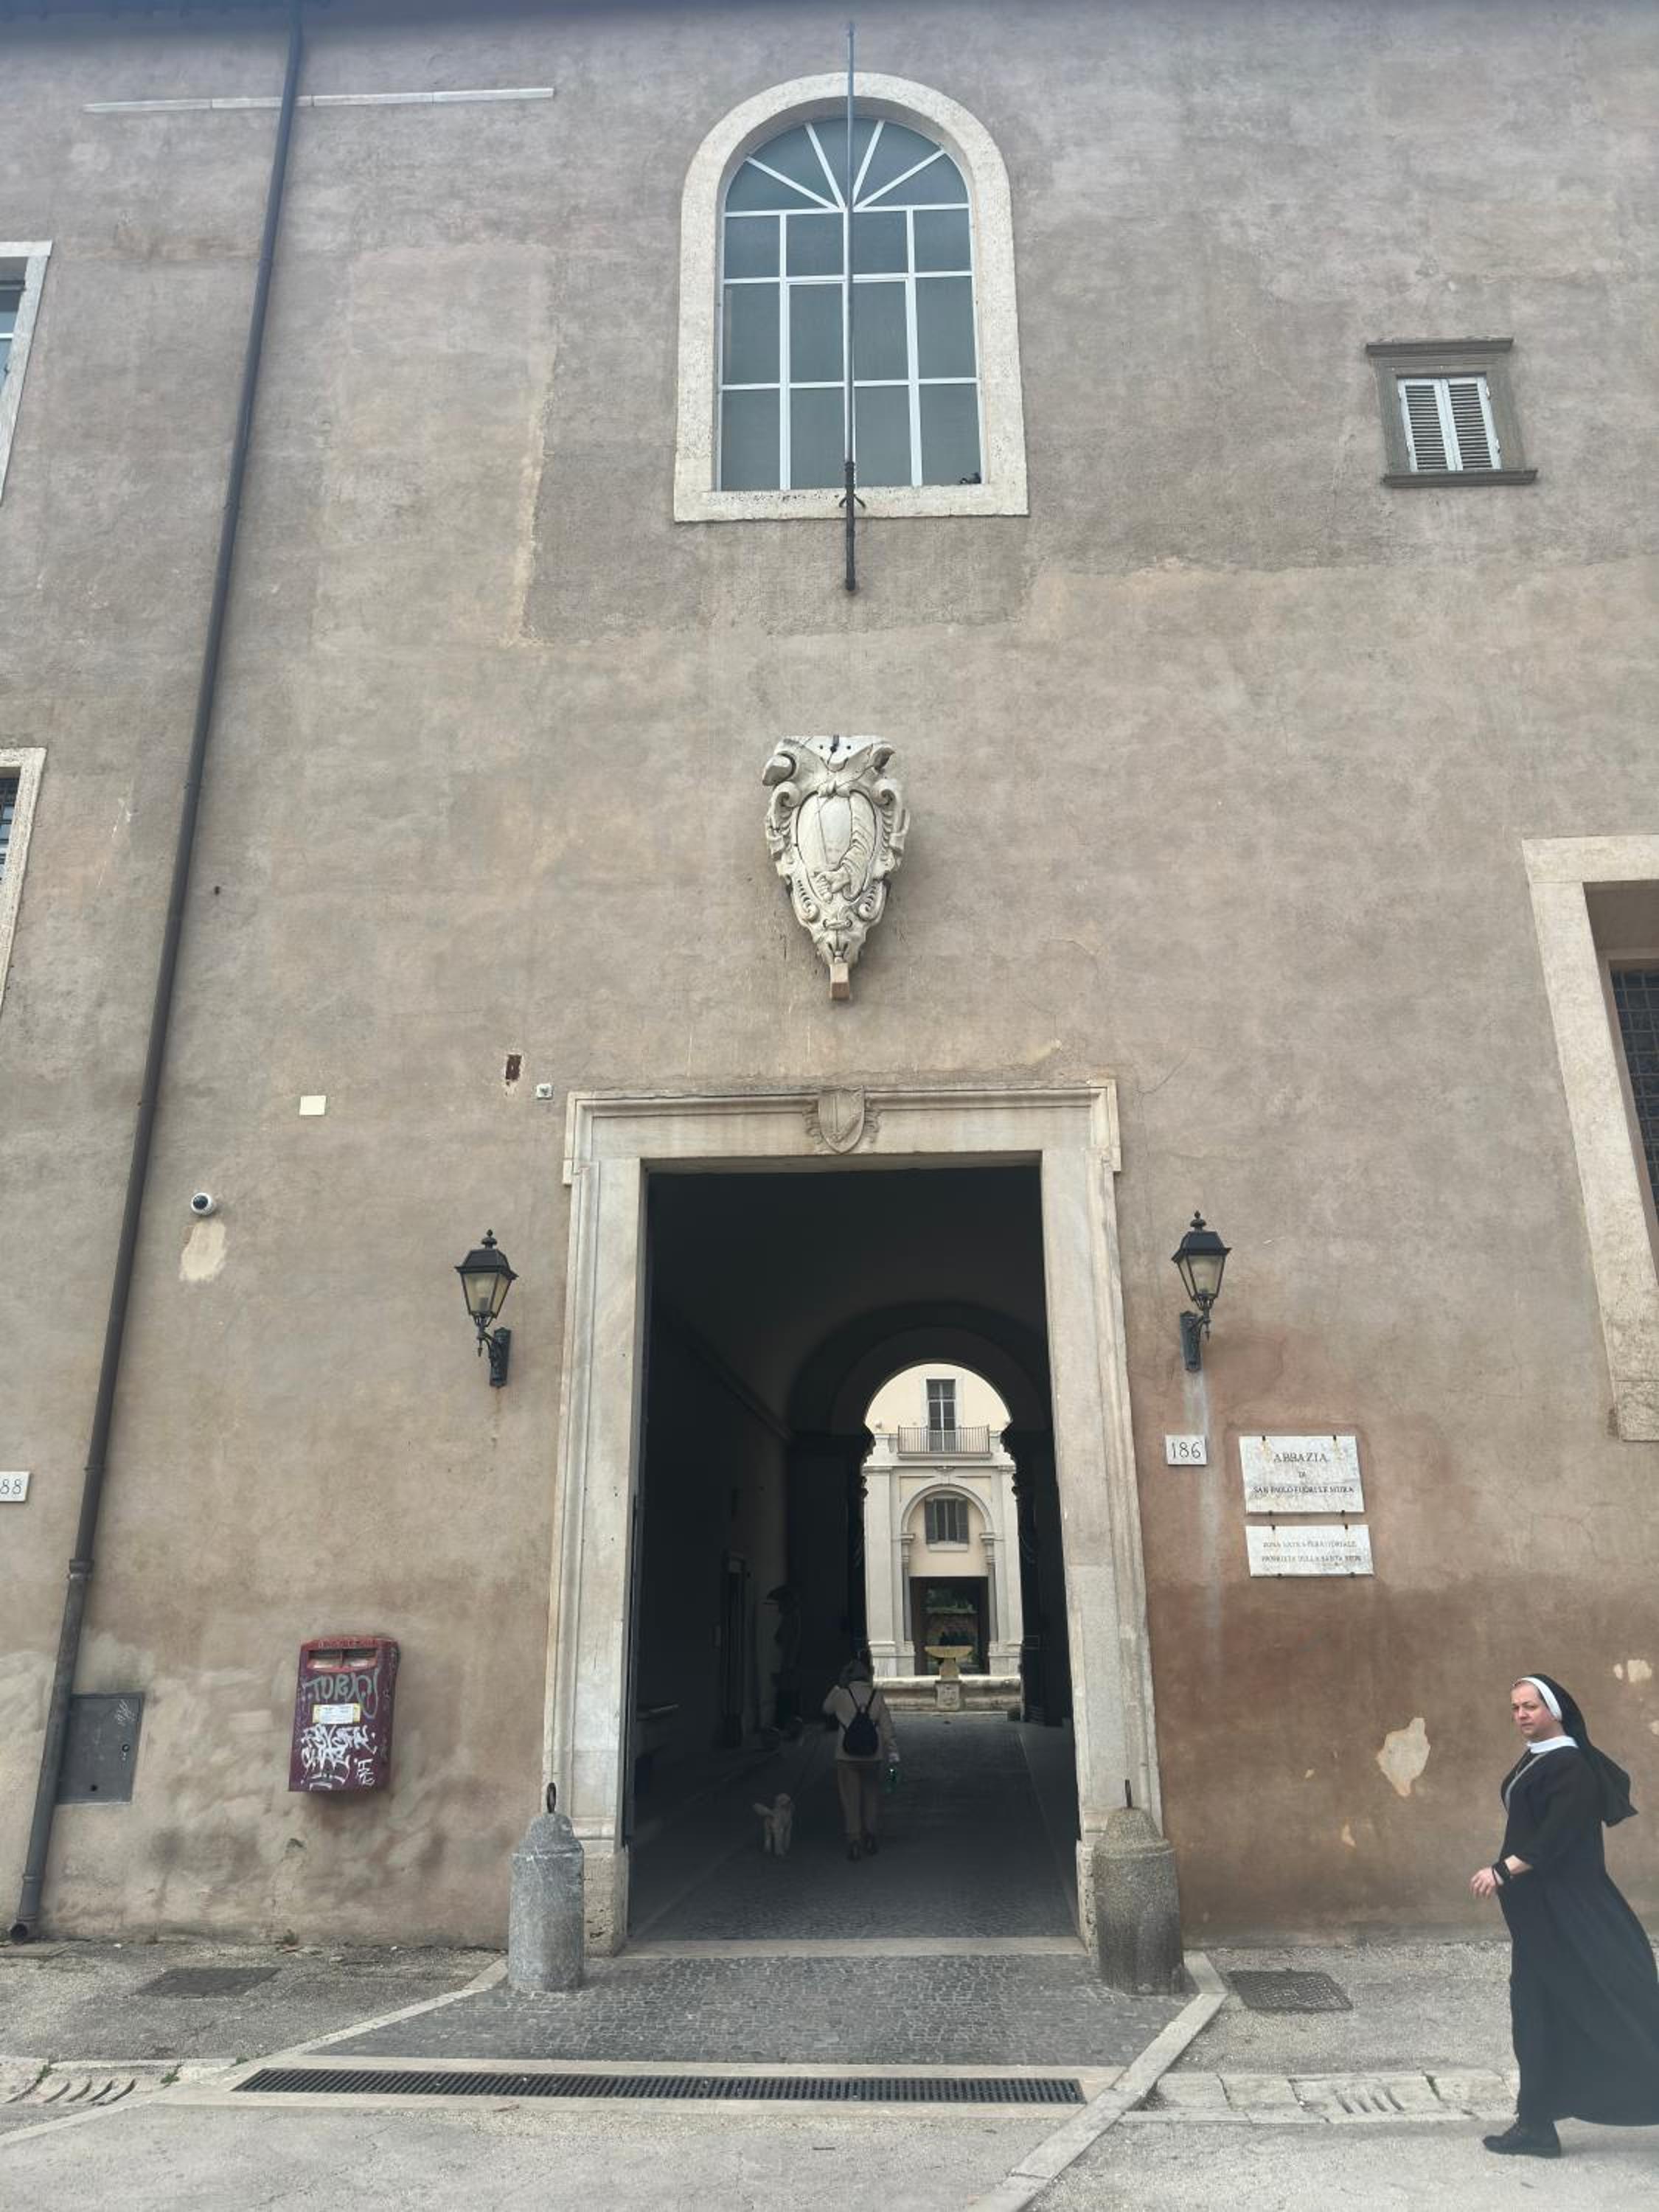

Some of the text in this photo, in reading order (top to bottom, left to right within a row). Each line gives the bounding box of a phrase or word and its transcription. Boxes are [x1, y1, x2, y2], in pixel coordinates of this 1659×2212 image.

[1172, 1441, 1201, 1459] 186
[1273, 1452, 1329, 1463] ABBAZIA
[1253, 1486, 1268, 1494] SAN
[1270, 1486, 1293, 1494] PAOLO
